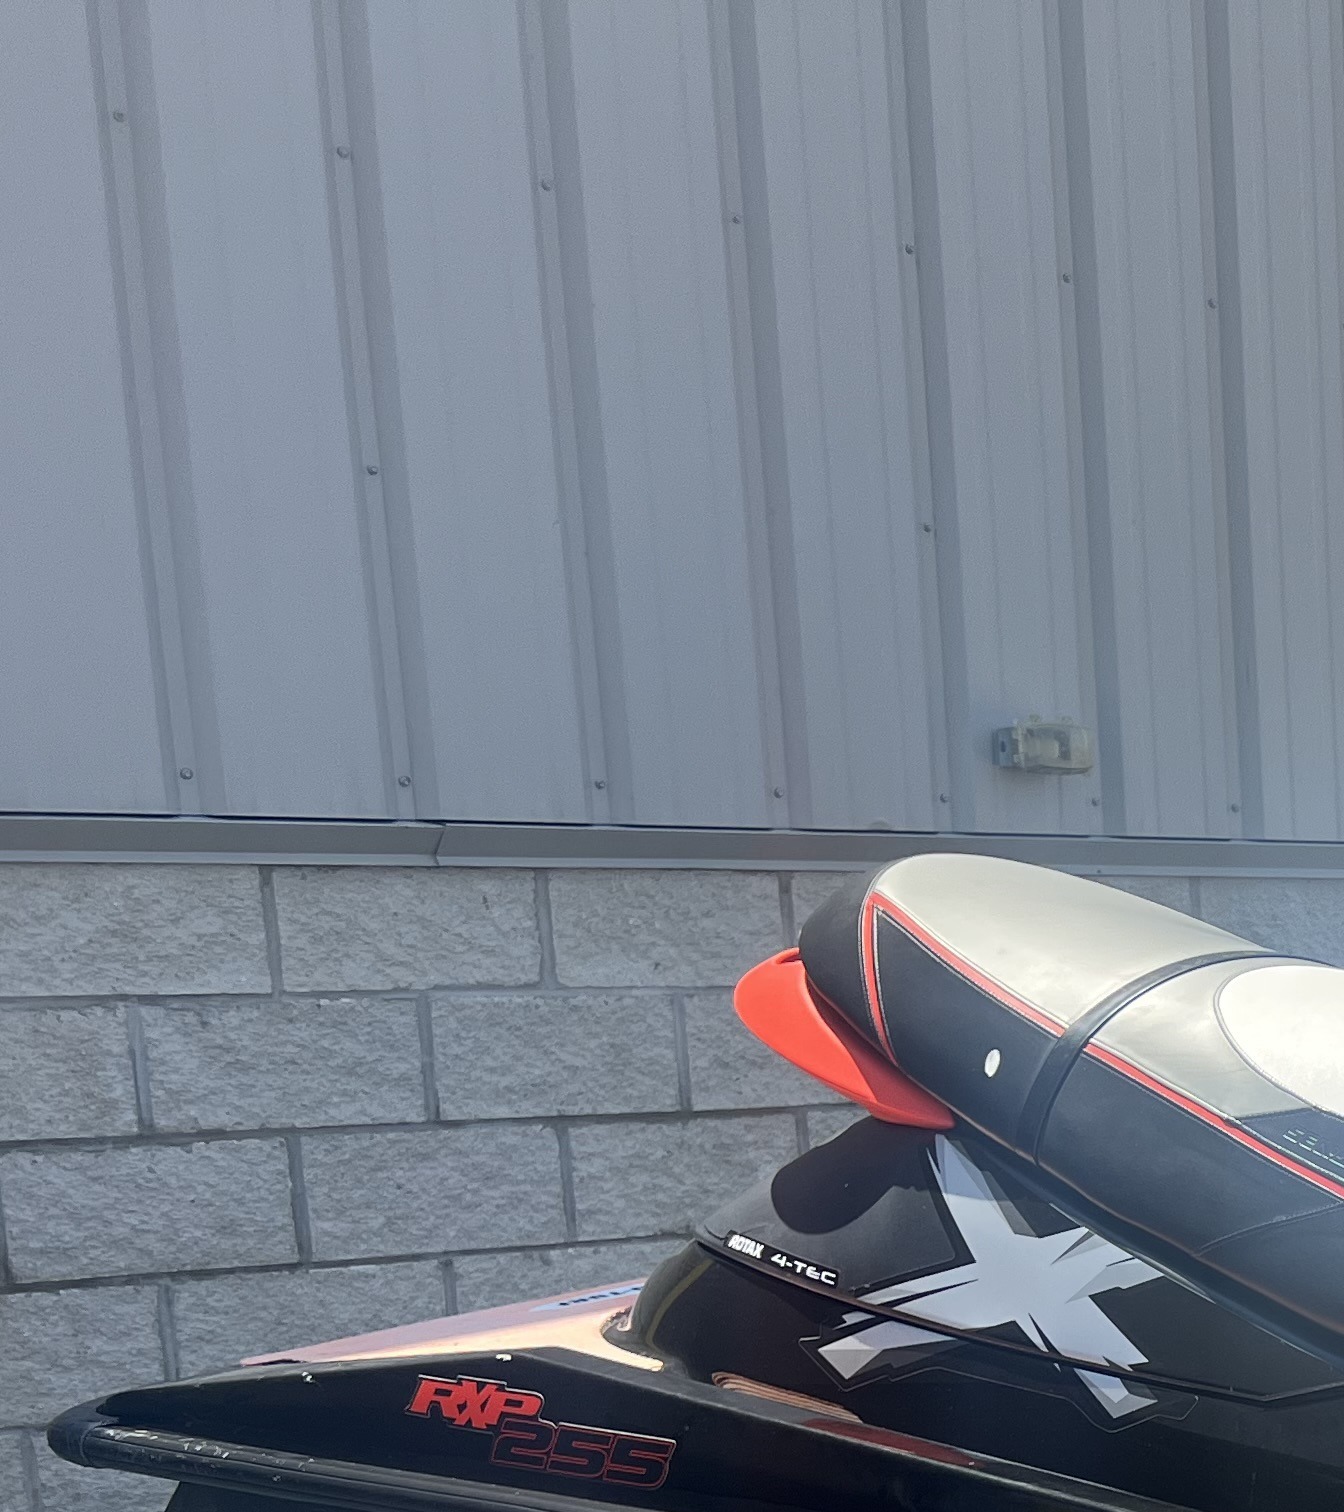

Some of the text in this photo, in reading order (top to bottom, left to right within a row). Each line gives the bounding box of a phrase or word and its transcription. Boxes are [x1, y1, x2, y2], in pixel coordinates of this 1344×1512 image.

[728, 1234, 765, 1259] ROTAX
[408, 1376, 544, 1430] RXP
[491, 1417, 677, 1491] 255
